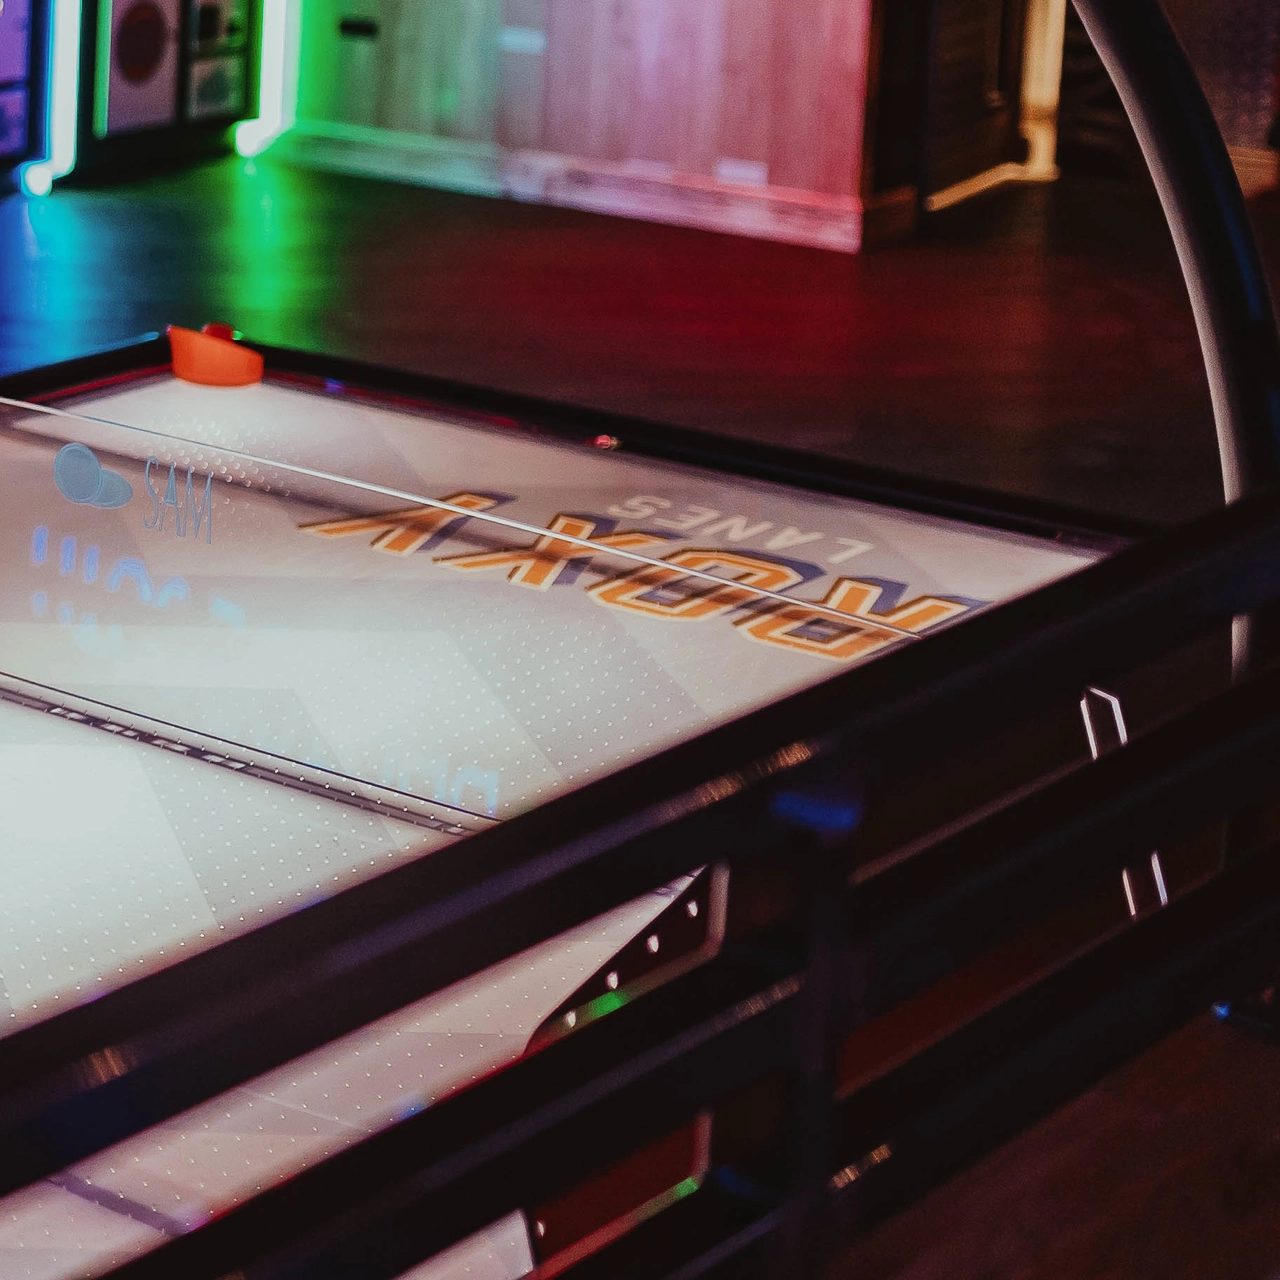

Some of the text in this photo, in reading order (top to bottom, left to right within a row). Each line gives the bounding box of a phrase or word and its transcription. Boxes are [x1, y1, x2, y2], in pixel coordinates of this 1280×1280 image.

[143, 456, 213, 545] SAM
[606, 493, 874, 566] LANES
[298, 492, 979, 662] ROXY
